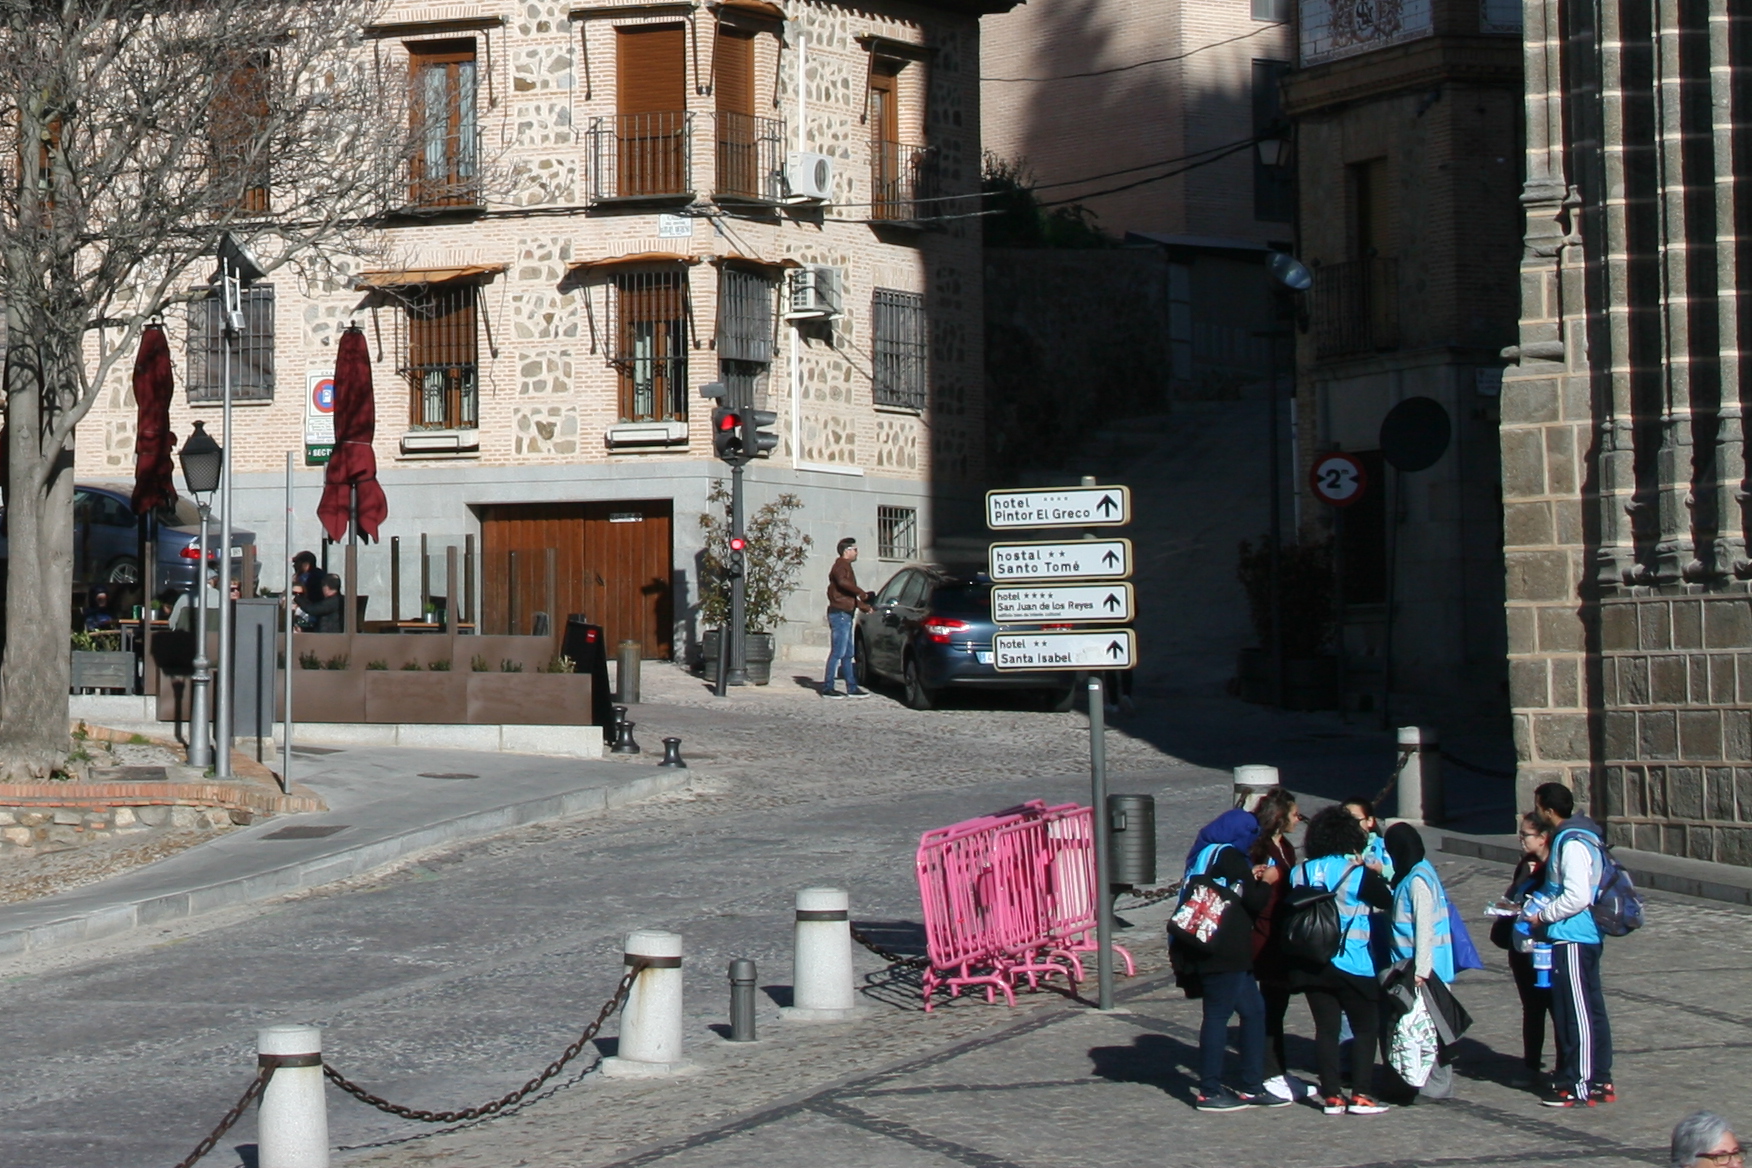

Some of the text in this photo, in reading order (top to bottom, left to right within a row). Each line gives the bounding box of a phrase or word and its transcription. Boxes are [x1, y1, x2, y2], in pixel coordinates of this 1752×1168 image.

[994, 497, 1030, 509] hotel
[995, 509, 1090, 522] Pintor El Greco
[996, 550, 1041, 561] hostal
[998, 561, 1080, 574] Santo Tomé
[997, 592, 1020, 601] hotel
[997, 600, 1094, 612] San Juan de los Reyes
[999, 639, 1026, 649] hotel
[1001, 654, 1033, 664] Santa
[1038, 652, 1073, 663] Isabel
